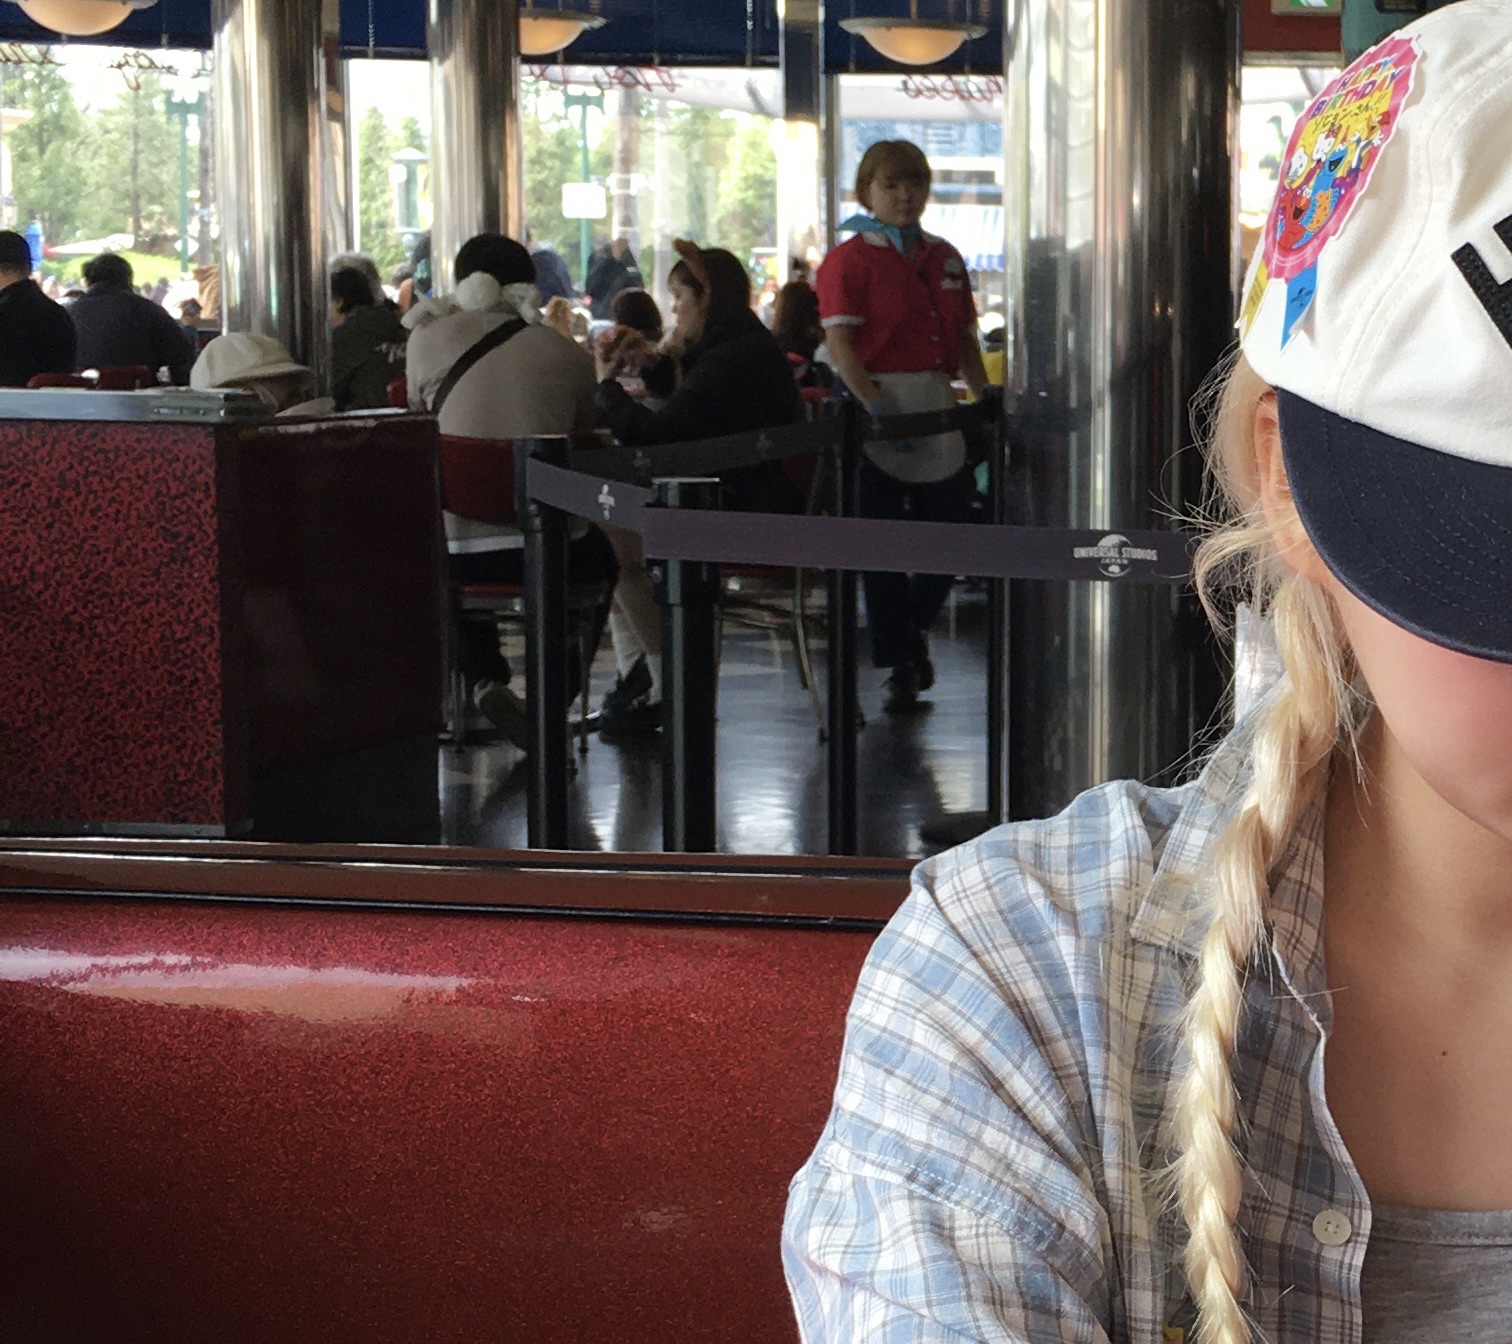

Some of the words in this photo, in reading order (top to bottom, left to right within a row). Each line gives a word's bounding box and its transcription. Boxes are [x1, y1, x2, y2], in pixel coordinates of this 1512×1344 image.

[1310, 65, 1406, 119] BIRTHDAY
[1336, 53, 1398, 94] HAPPY
[1073, 546, 1119, 559] UNIVERSAL
[1121, 547, 1158, 561] STUDIOS
